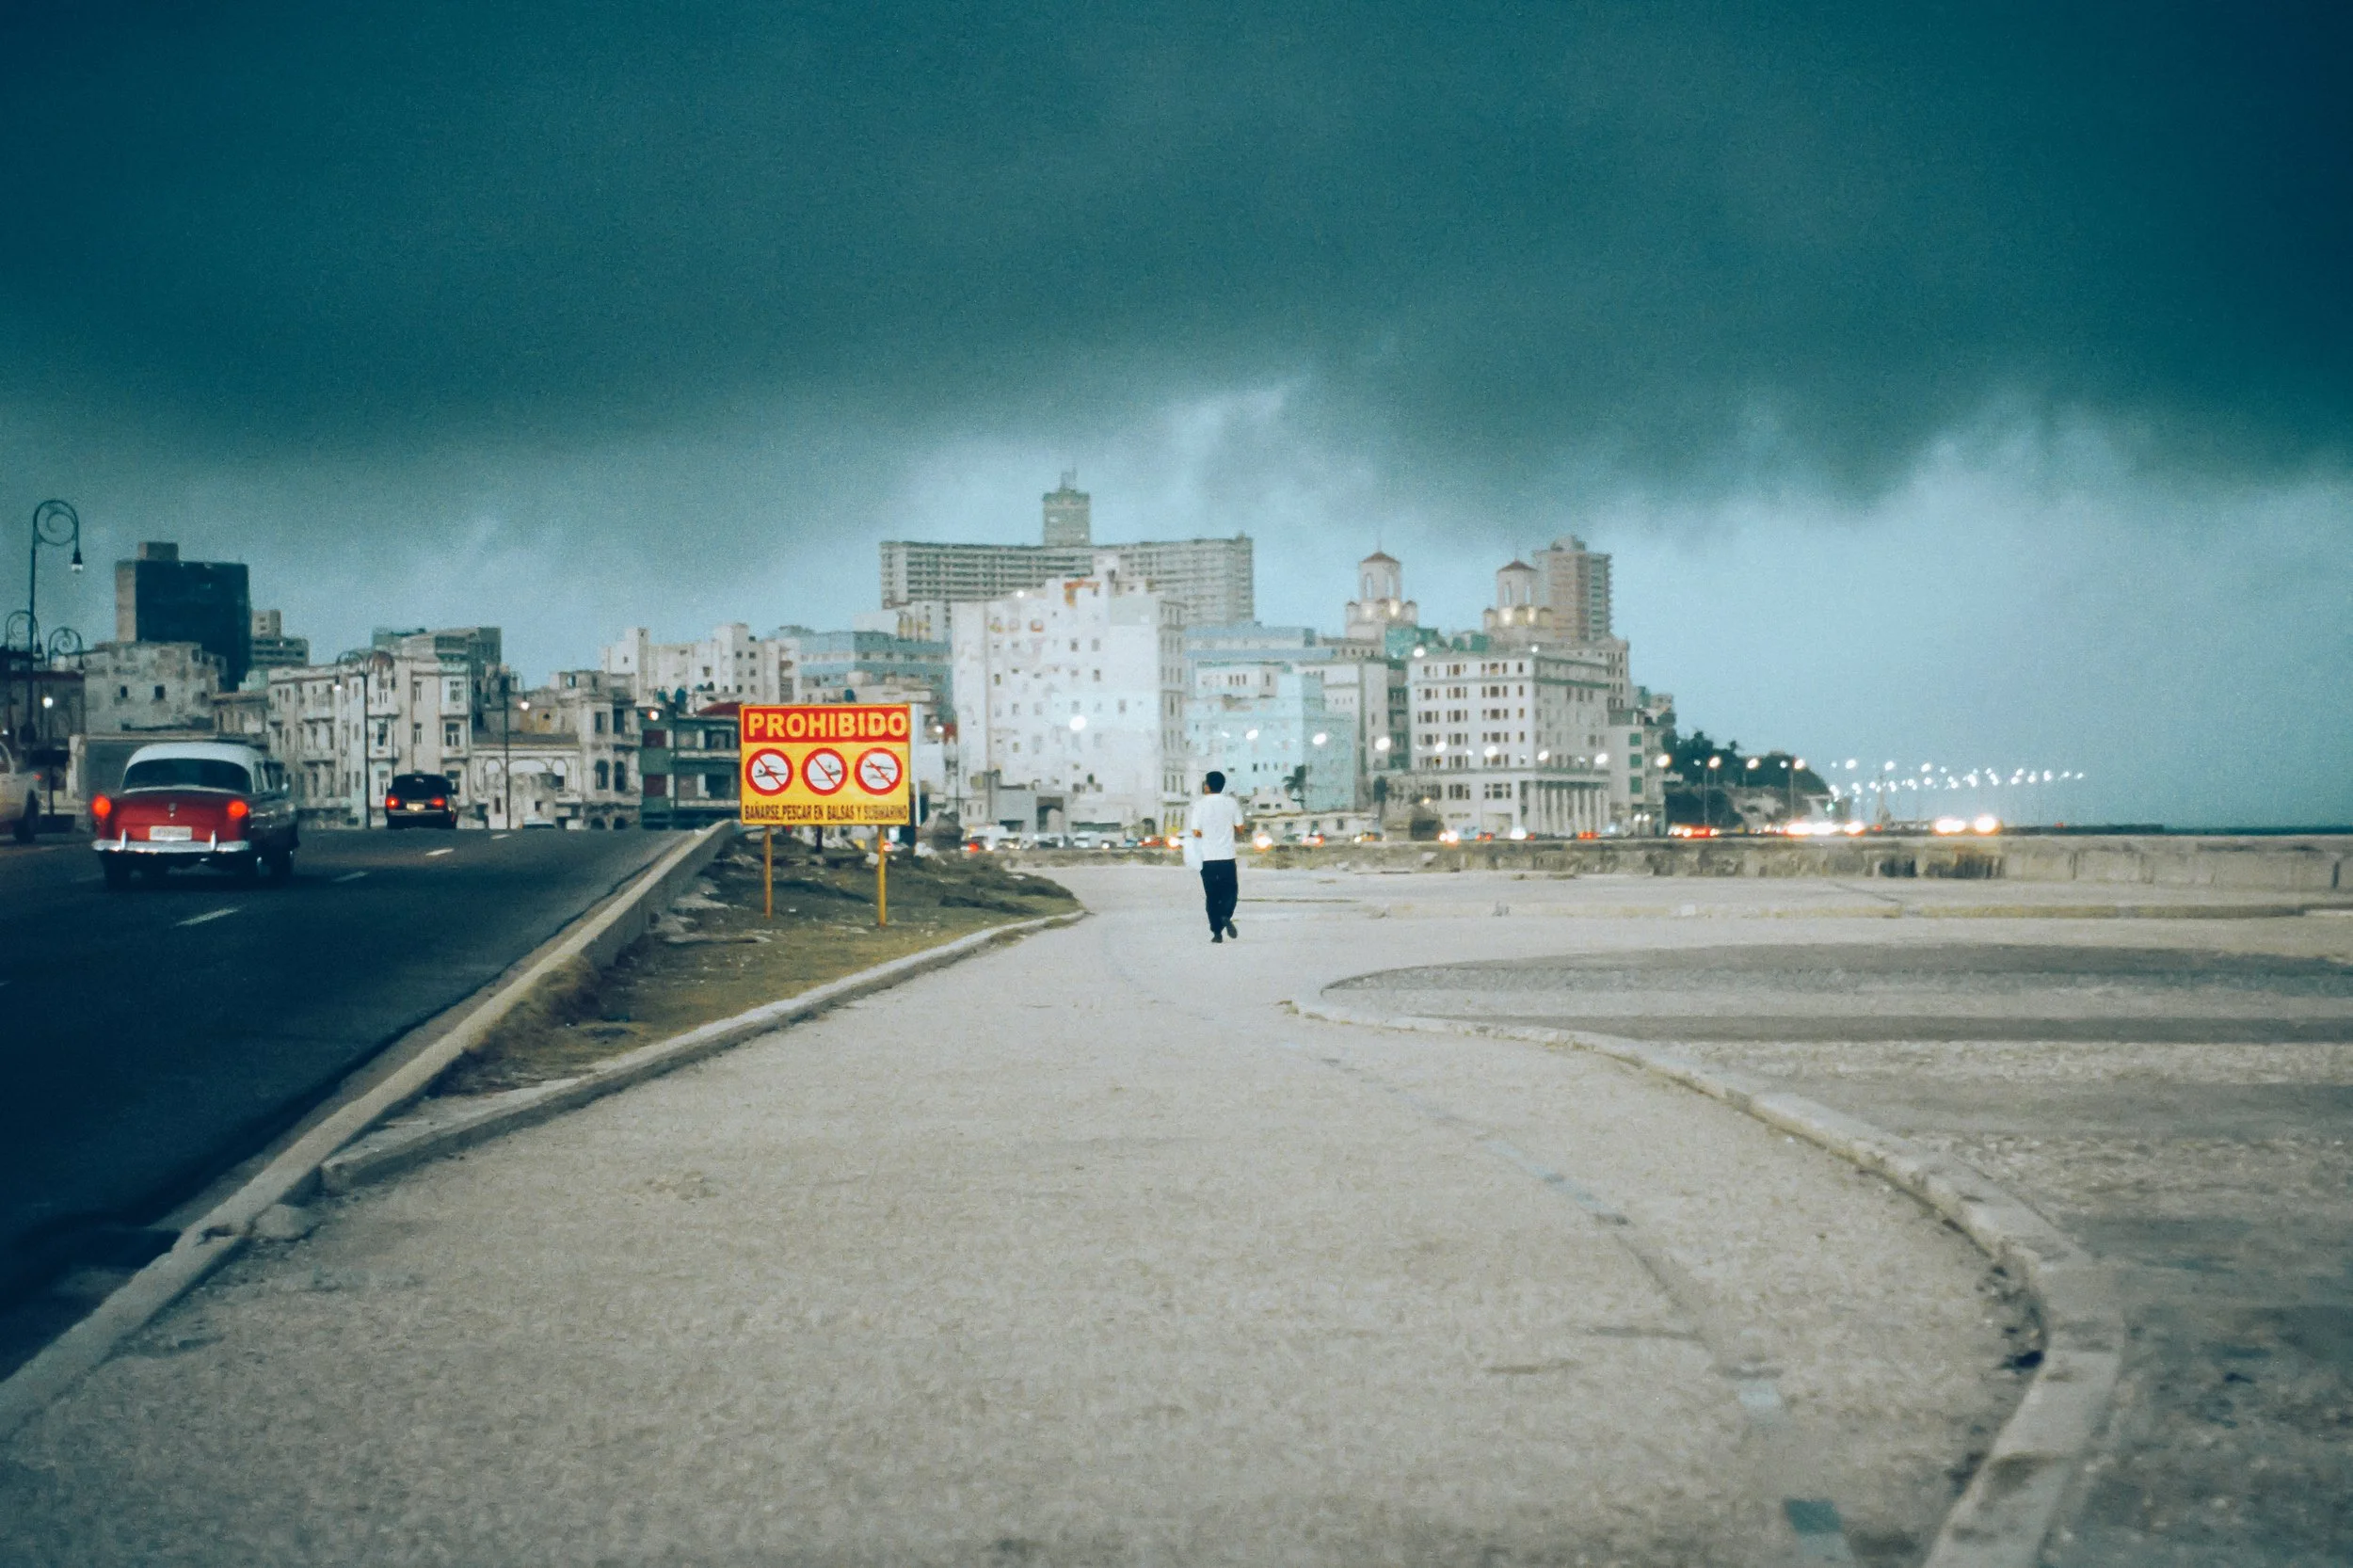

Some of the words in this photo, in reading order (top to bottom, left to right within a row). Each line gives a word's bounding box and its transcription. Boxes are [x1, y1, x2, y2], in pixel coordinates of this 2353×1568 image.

[748, 712, 907, 738] PROHIBIDO
[783, 805, 811, 820] PESCAR
[814, 805, 824, 820] EN
[827, 805, 854, 820] BALSAS
[856, 805, 862, 821] Y
